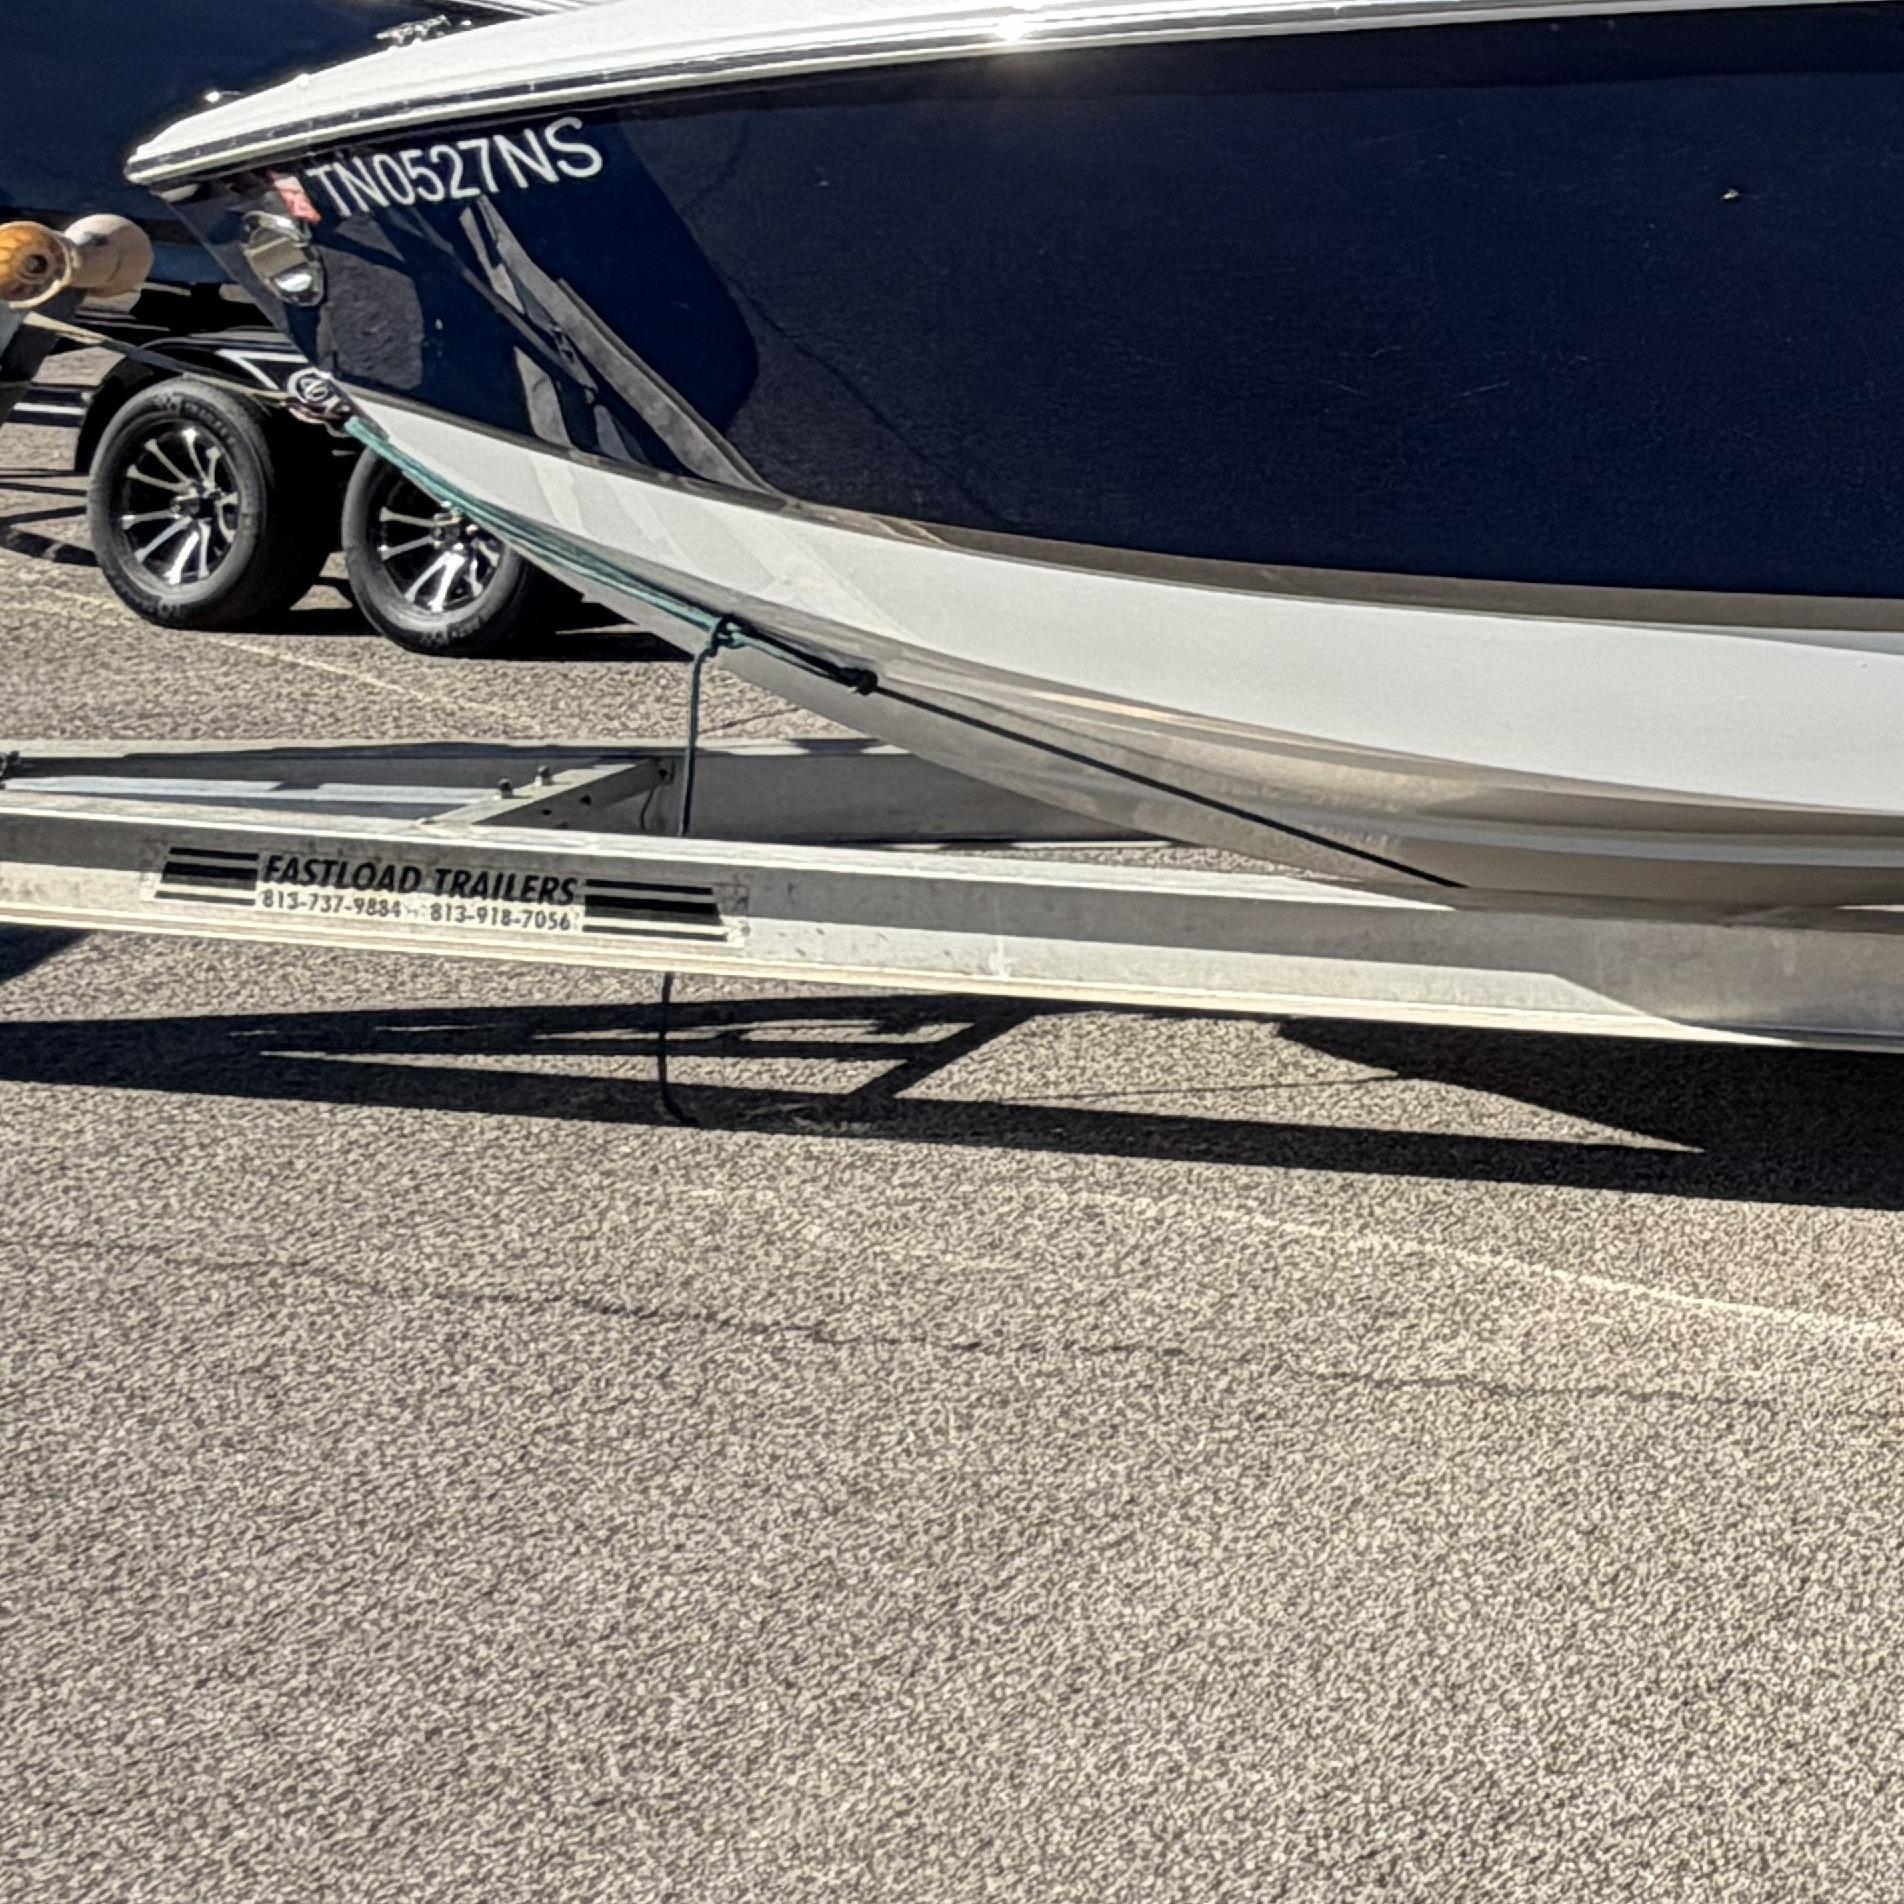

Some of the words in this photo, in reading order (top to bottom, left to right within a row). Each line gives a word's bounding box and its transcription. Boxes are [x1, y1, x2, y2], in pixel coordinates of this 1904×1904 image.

[304, 116, 604, 217] TN0527NS
[263, 854, 422, 895] FASTLOAD
[434, 868, 579, 906] TRAILERS
